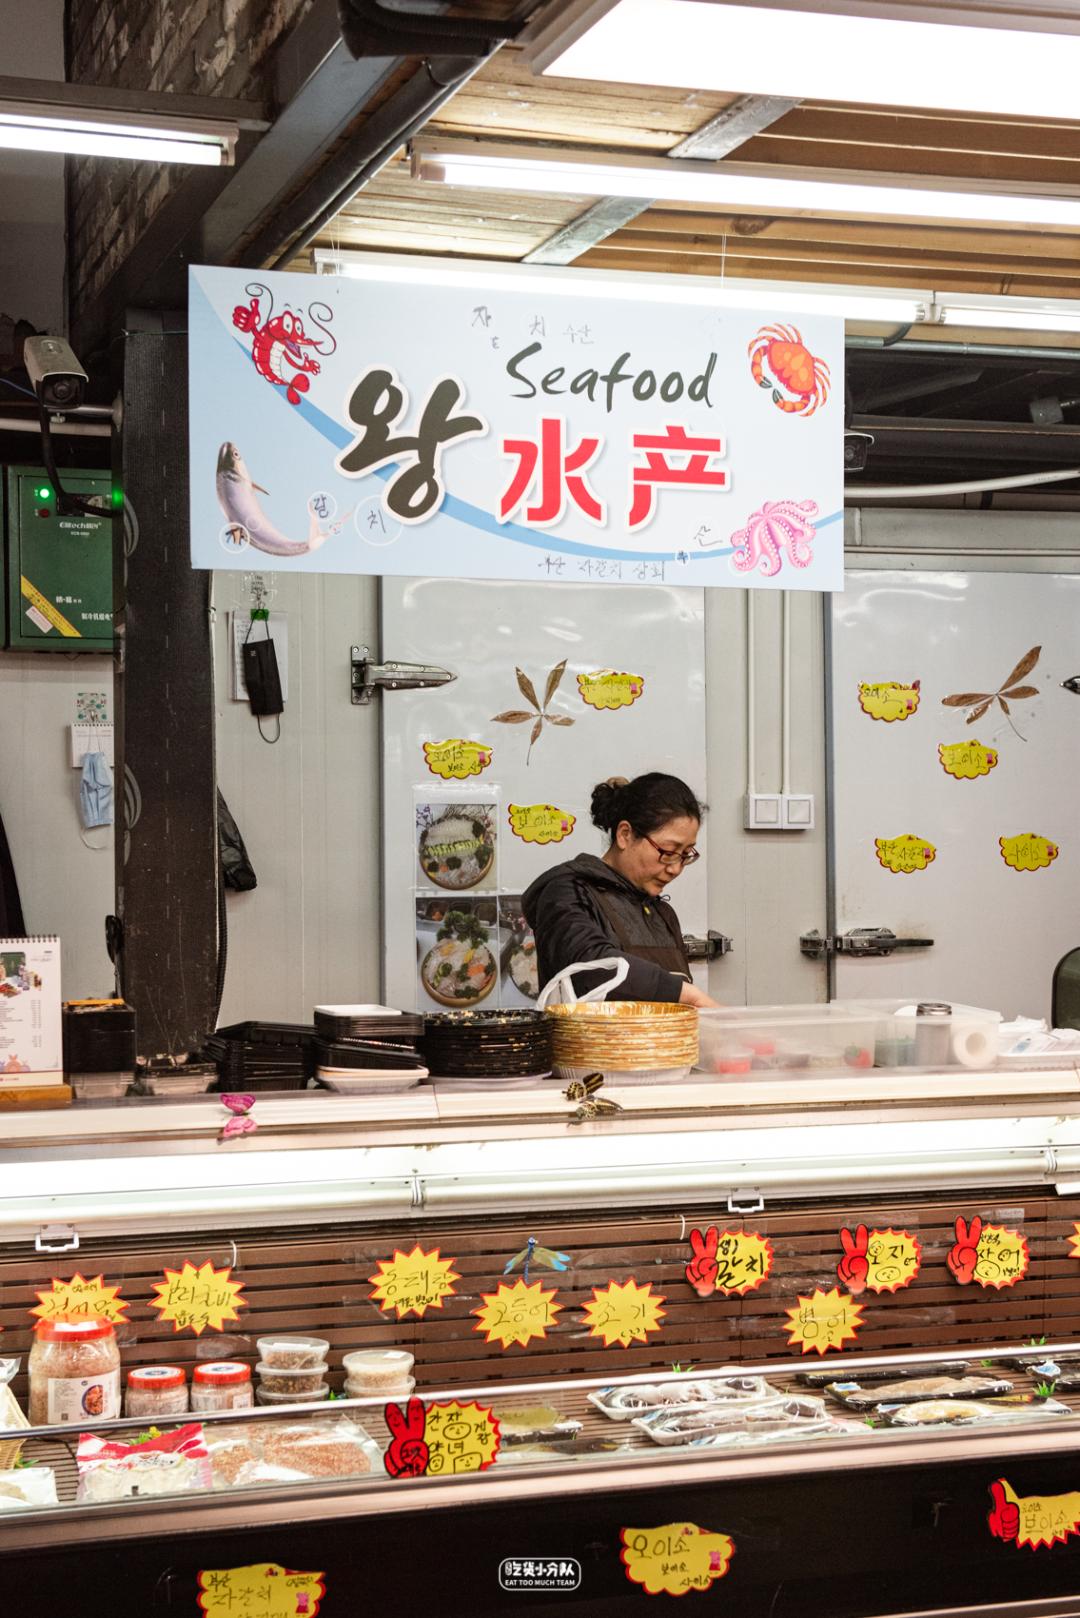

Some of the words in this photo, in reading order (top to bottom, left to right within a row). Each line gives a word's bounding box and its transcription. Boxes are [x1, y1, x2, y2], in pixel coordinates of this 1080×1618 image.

[506, 342, 718, 413] Seafood
[340, 369, 484, 519] 왕
[500, 417, 726, 527] 水产
[708, 1252, 764, 1290] 갈치
[493, 1297, 549, 1328] 고등어
[598, 1301, 646, 1328] 조기
[799, 1307, 847, 1340] 병어
[633, 1534, 691, 1560] 오이소
